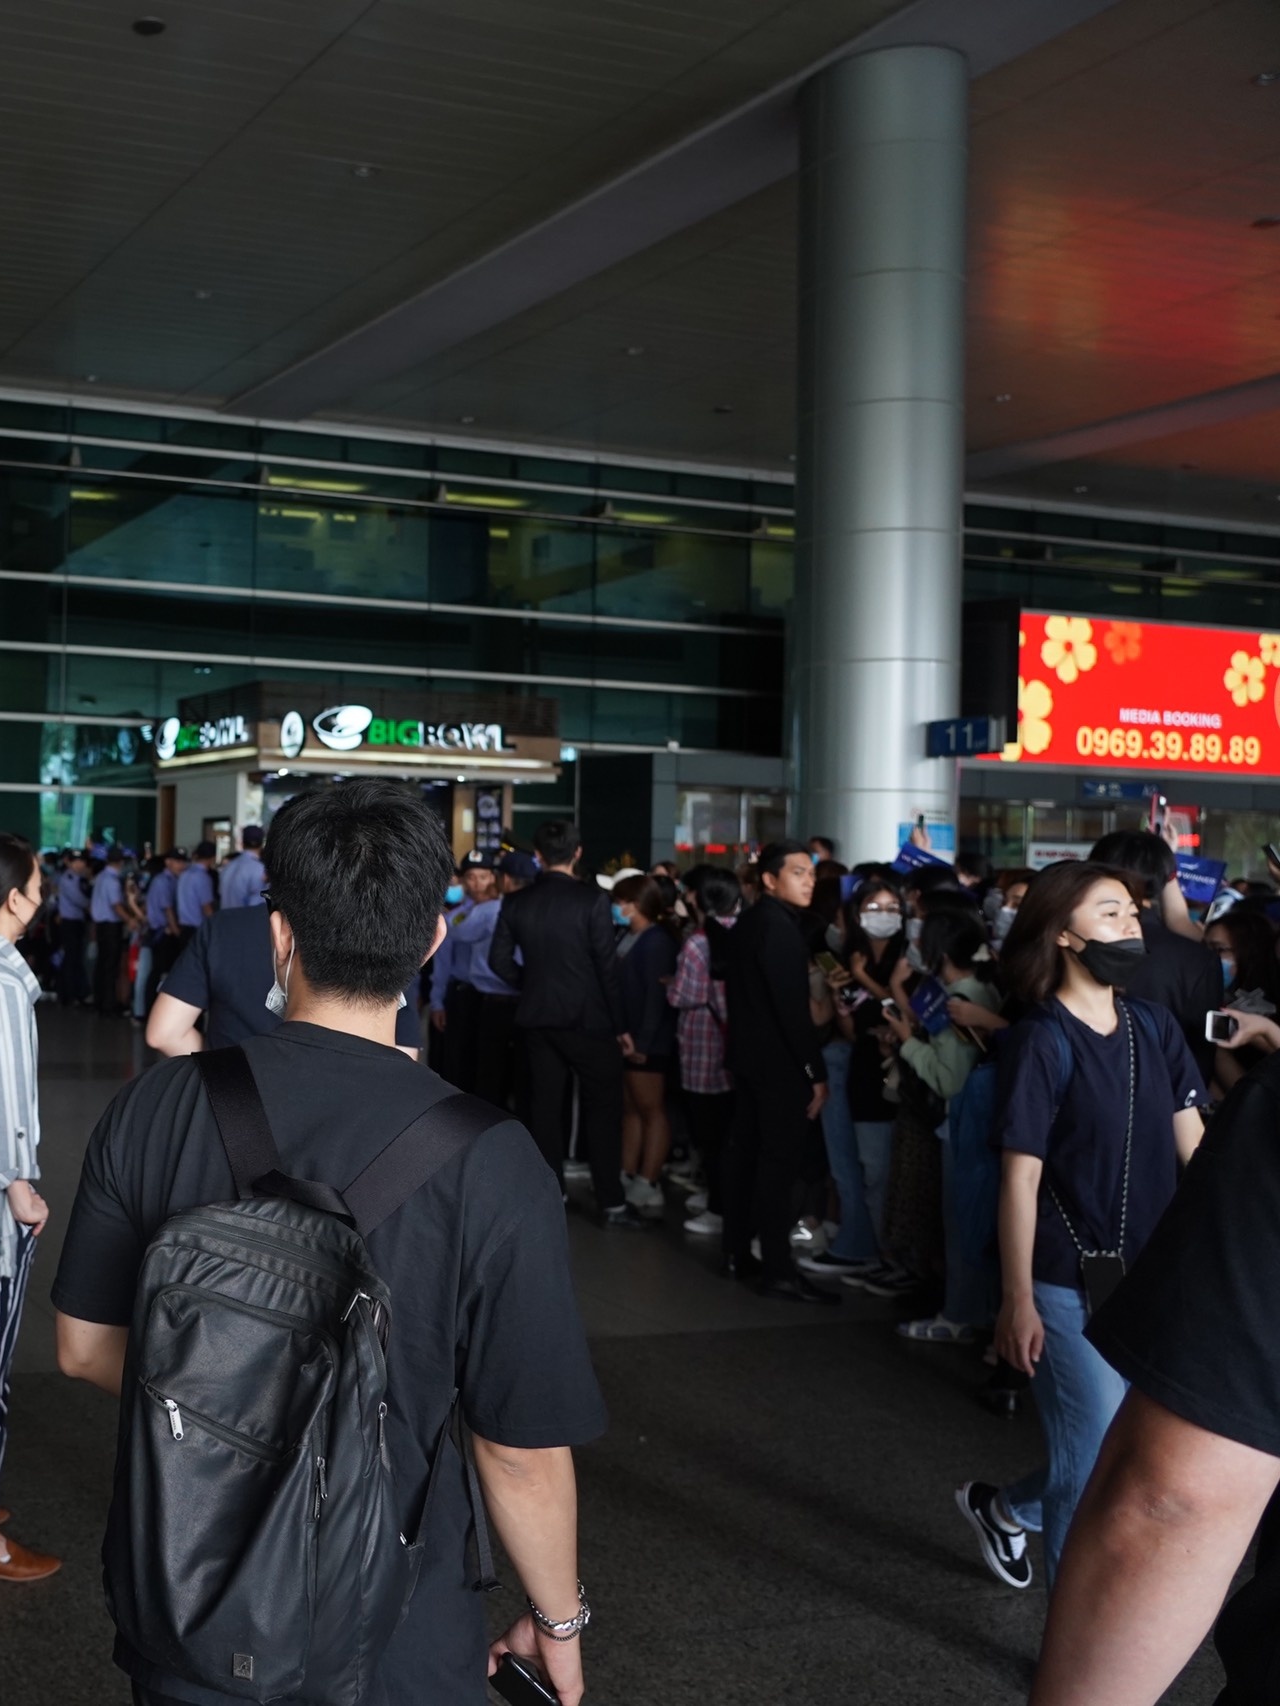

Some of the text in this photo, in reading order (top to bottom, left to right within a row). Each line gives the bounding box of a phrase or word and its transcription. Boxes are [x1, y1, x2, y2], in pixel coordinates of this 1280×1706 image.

[1120, 708, 1222, 729] MEDIA BOOKING
[1076, 726, 1261, 766] 0969.39.89.89
